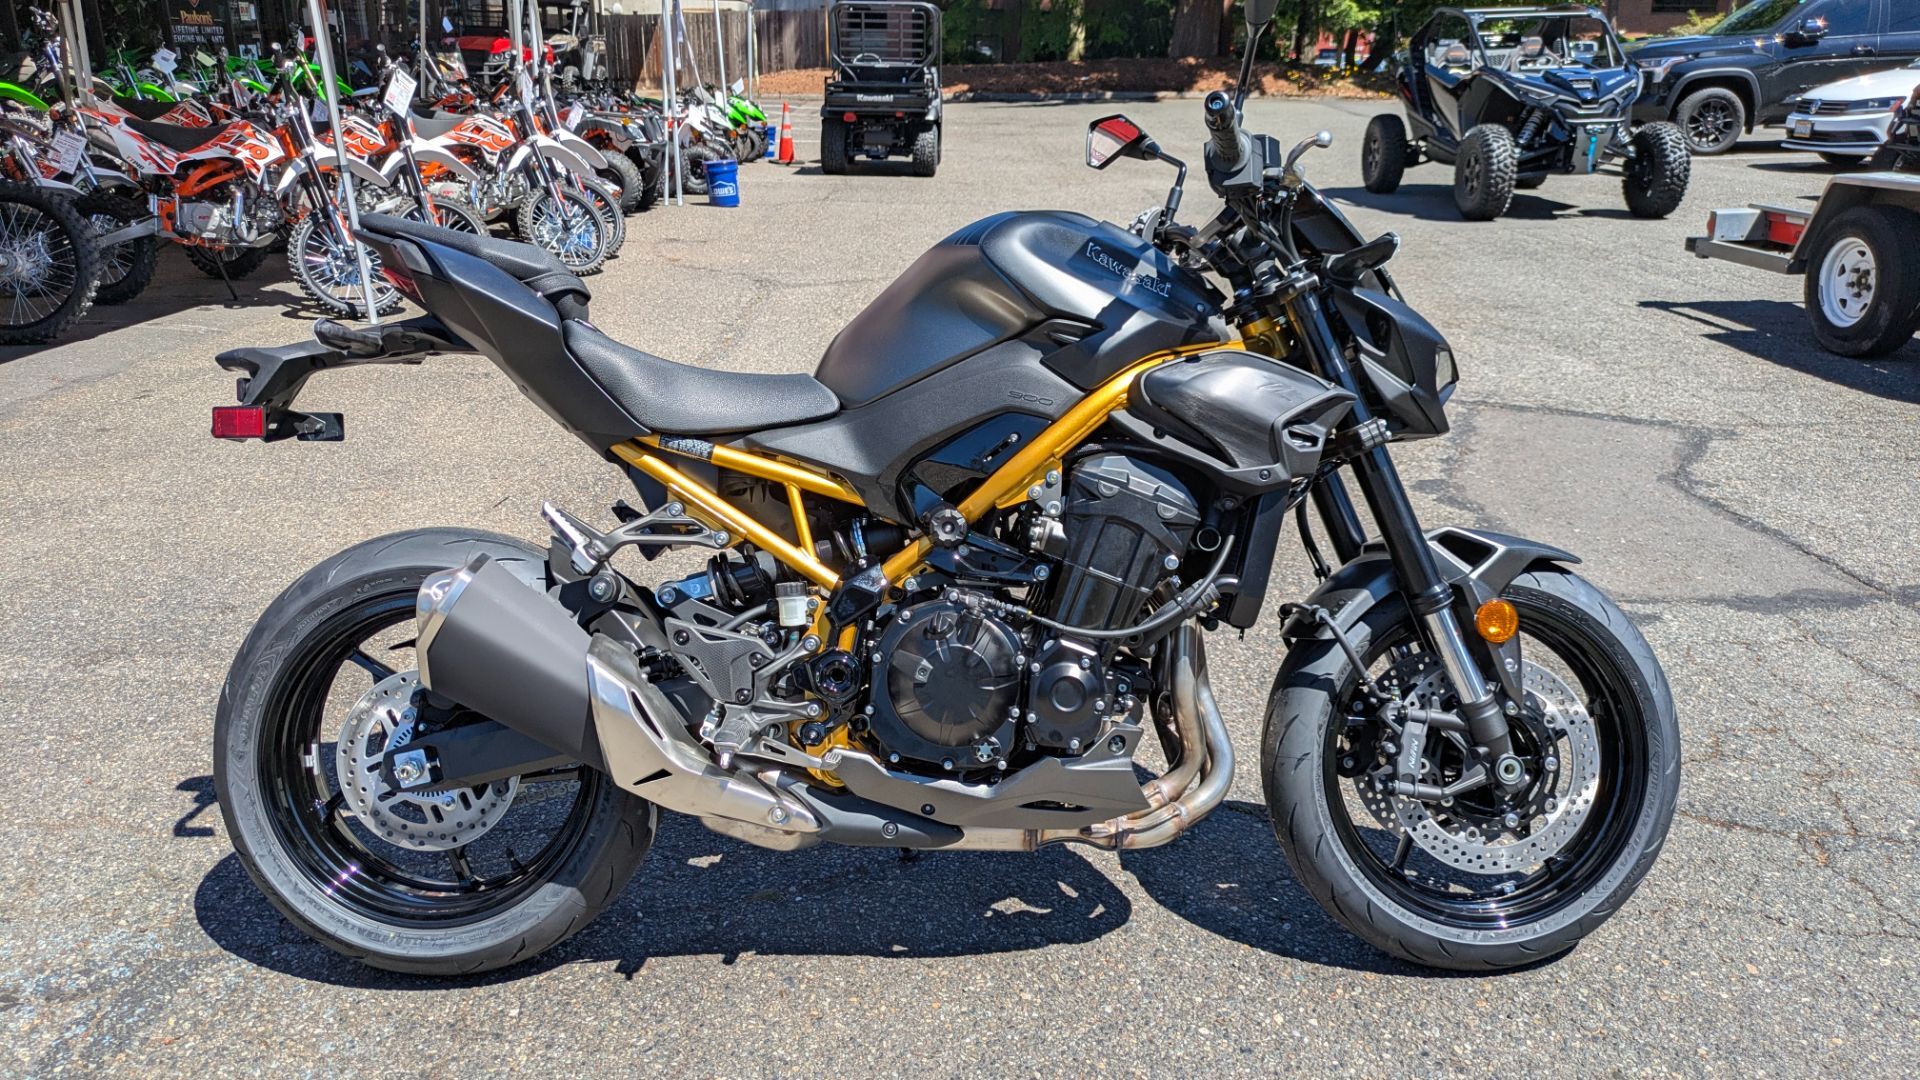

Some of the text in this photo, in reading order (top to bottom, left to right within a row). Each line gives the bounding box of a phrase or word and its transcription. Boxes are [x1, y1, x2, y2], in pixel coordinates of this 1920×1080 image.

[180, 10, 213, 24] Paulson's
[172, 25, 224, 34] LIFETIME LIMITED
[174, 34, 224, 44] ENGINE WAANTY
[856, 94, 894, 102] Kawasaki
[1086, 242, 1171, 297] Kawasaki
[1008, 391, 1053, 406] 900
